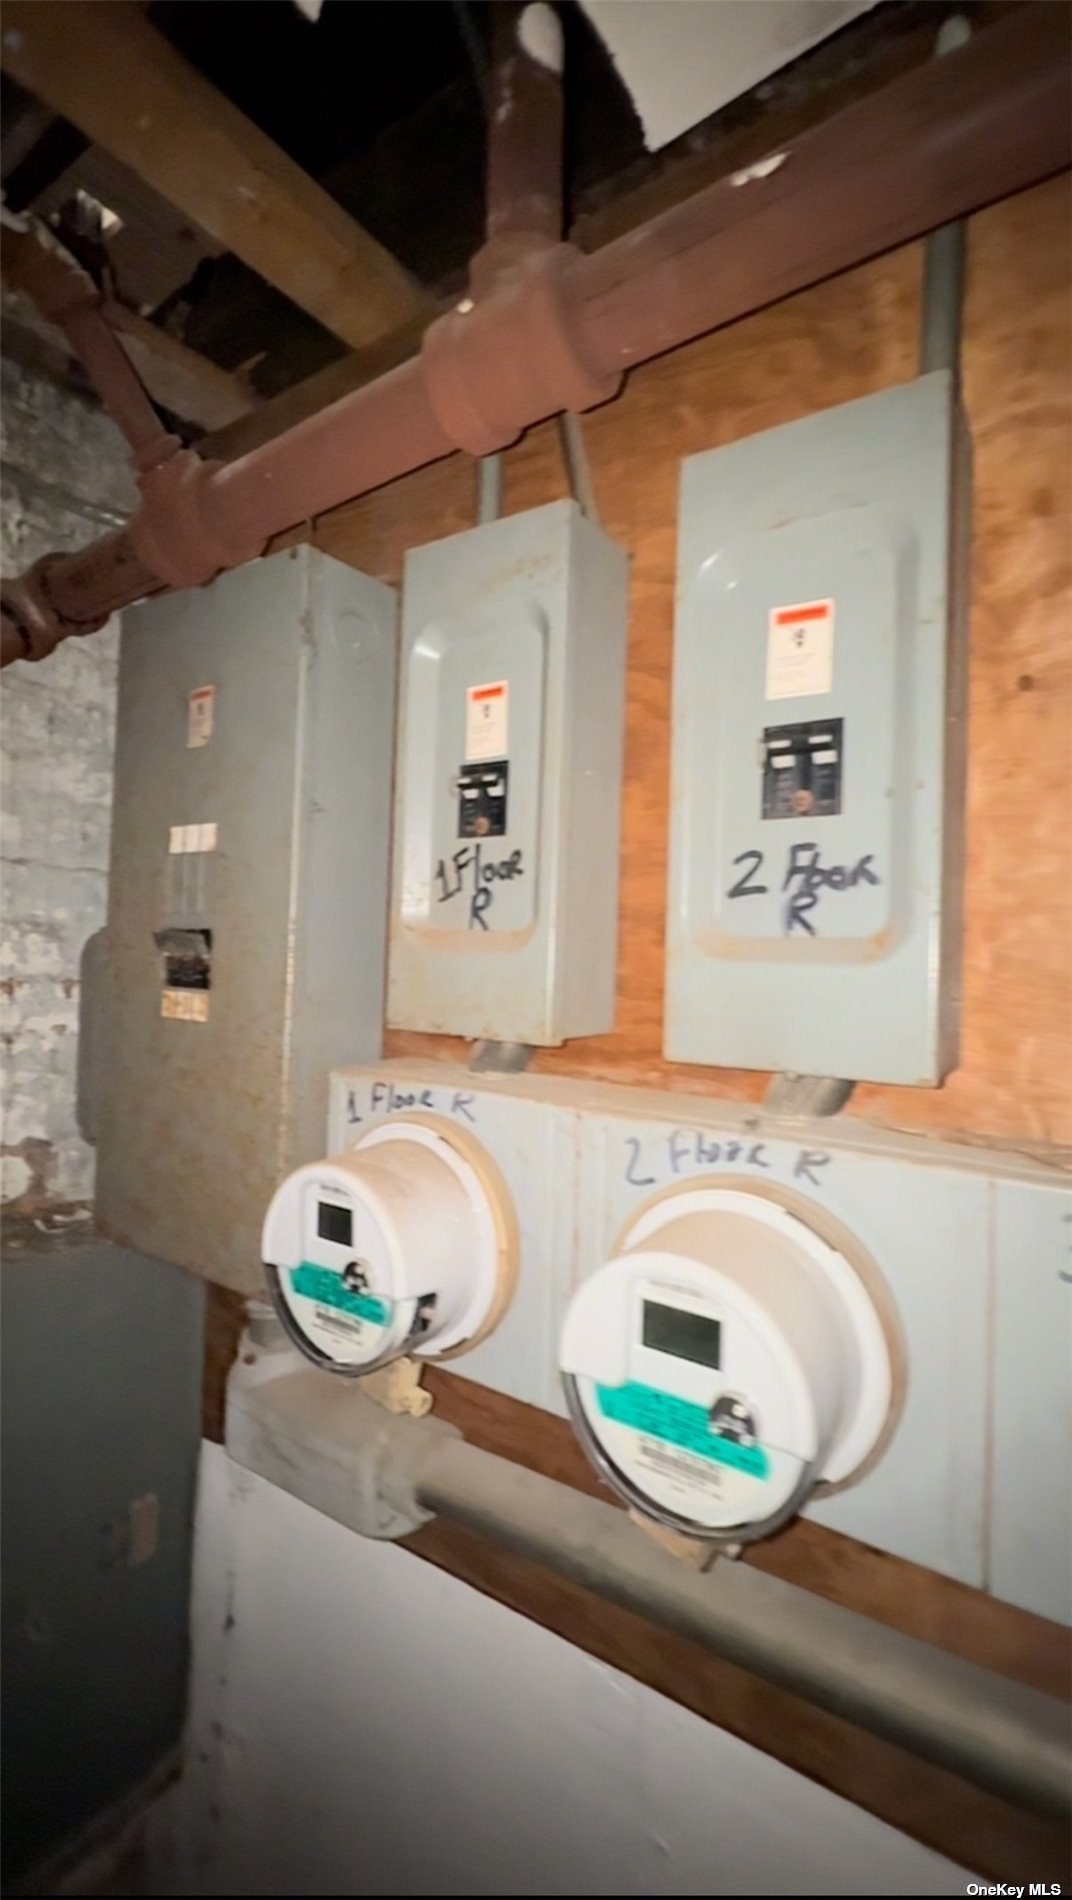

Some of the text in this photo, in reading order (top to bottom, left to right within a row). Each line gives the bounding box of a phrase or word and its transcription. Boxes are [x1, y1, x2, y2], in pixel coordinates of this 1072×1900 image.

[434, 859, 461, 902] 1
[727, 850, 768, 898] 2
[469, 887, 493, 931] R
[786, 889, 818, 937] R
[347, 1090, 362, 1123] 1
[625, 1137, 656, 1185] 2
[794, 1150, 830, 1186] R
